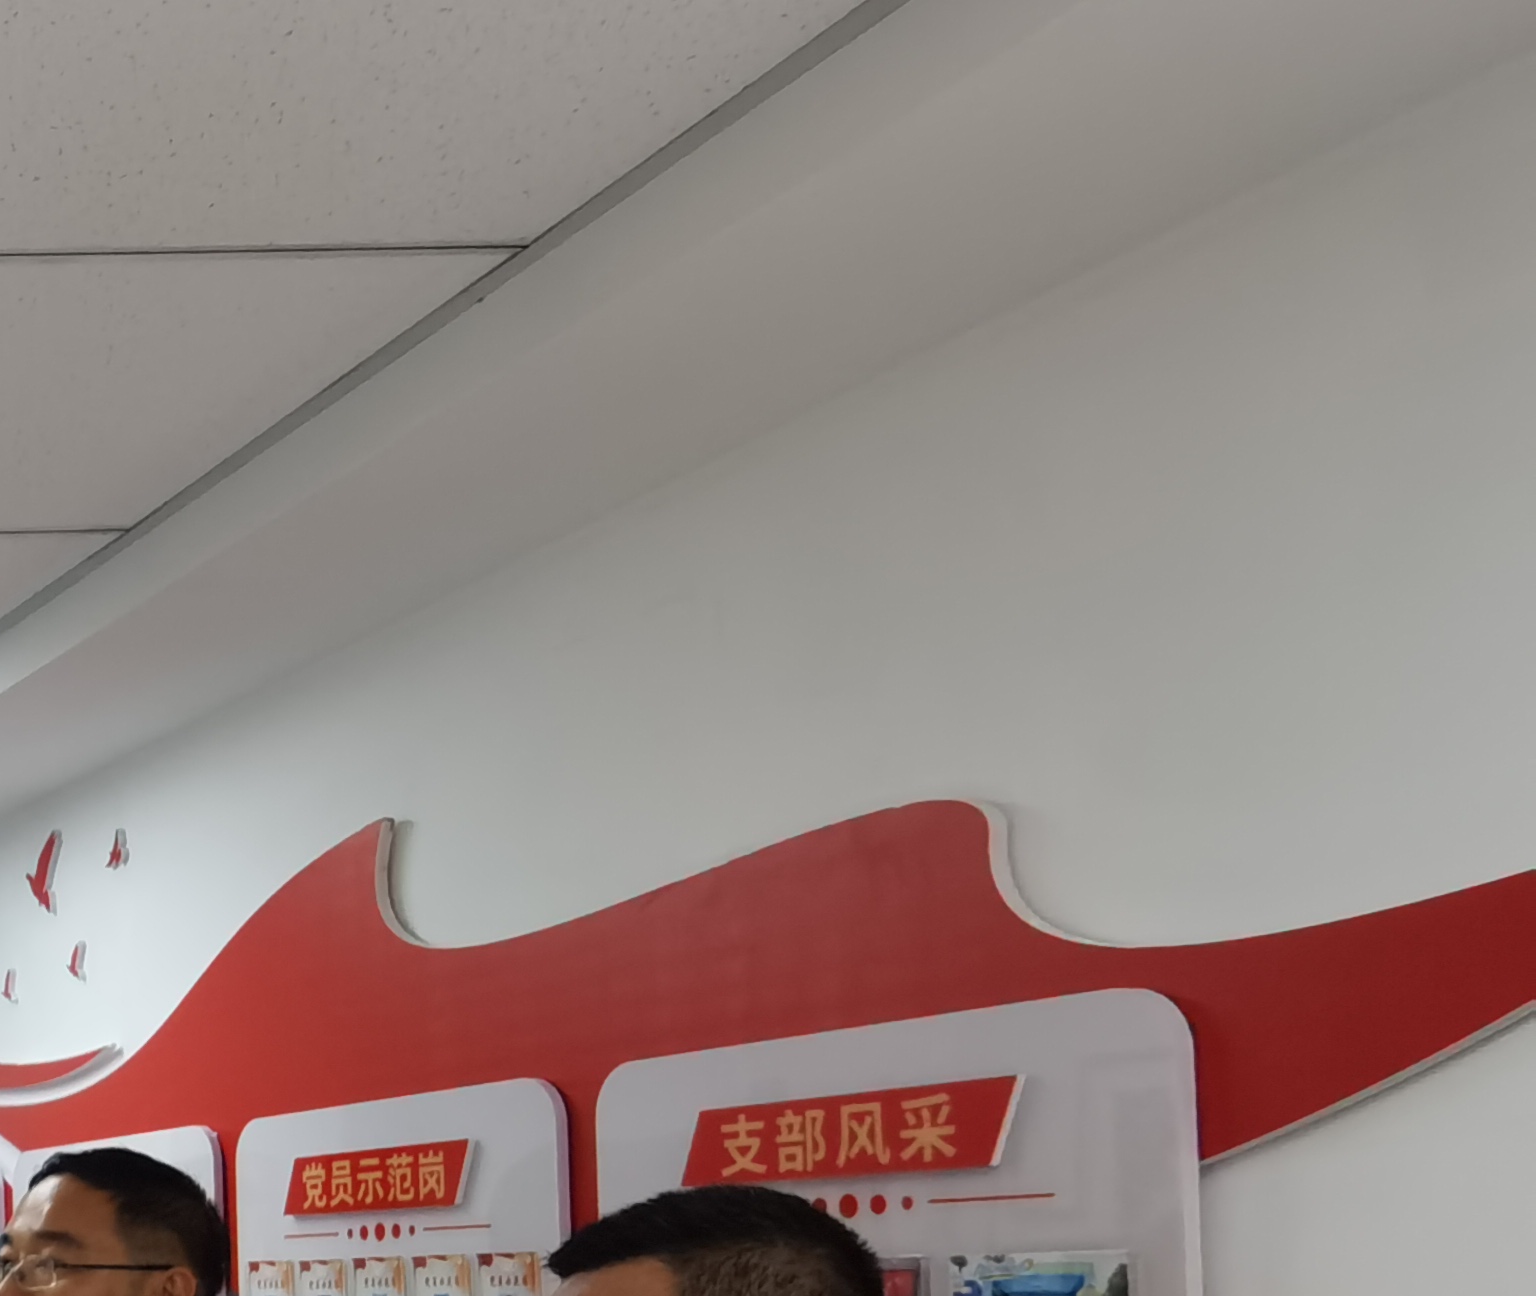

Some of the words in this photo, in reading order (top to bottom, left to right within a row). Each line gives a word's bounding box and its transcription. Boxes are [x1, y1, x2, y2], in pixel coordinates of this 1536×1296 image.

[720, 1092, 957, 1177] 支部风采
[301, 1149, 446, 1210] 党员示范岗
